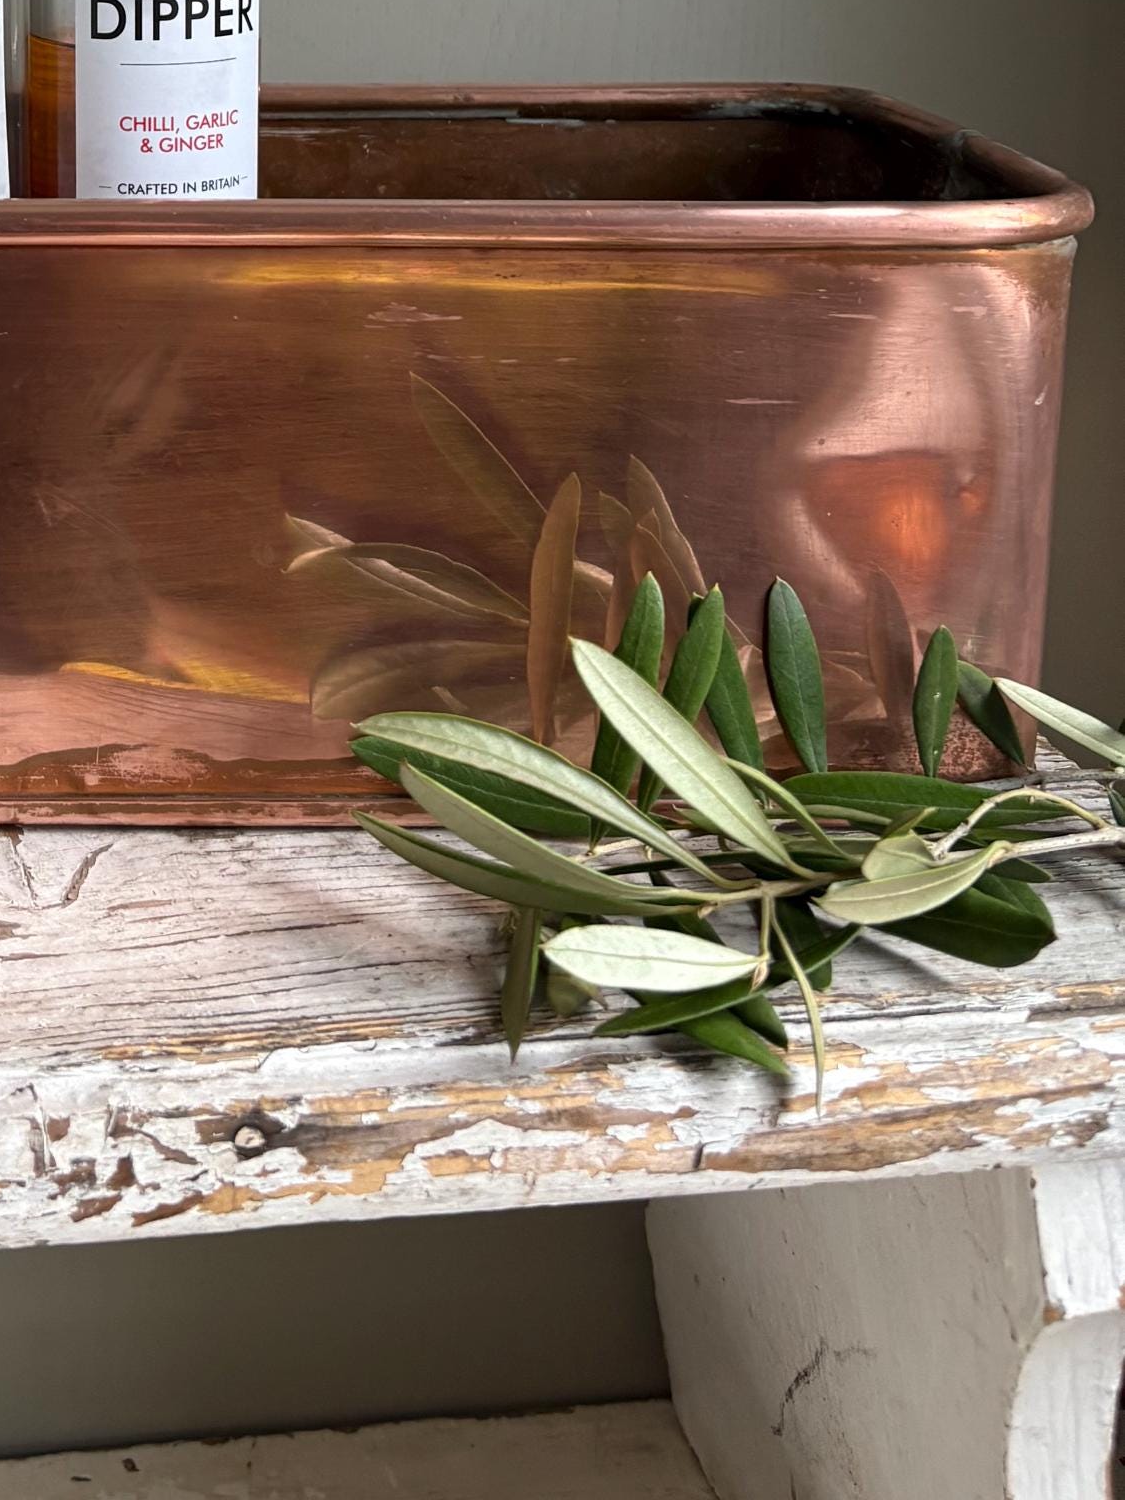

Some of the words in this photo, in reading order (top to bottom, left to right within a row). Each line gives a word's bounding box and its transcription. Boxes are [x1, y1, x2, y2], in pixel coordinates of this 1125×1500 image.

[119, 115, 181, 134] CHILLI,
[185, 109, 239, 130] GARLIC
[140, 138, 153, 153] &
[159, 133, 224, 153] GINGER
[117, 182, 178, 195] CRAFTED
[182, 181, 197, 194] IN
[201, 174, 240, 192] BRITAIN
